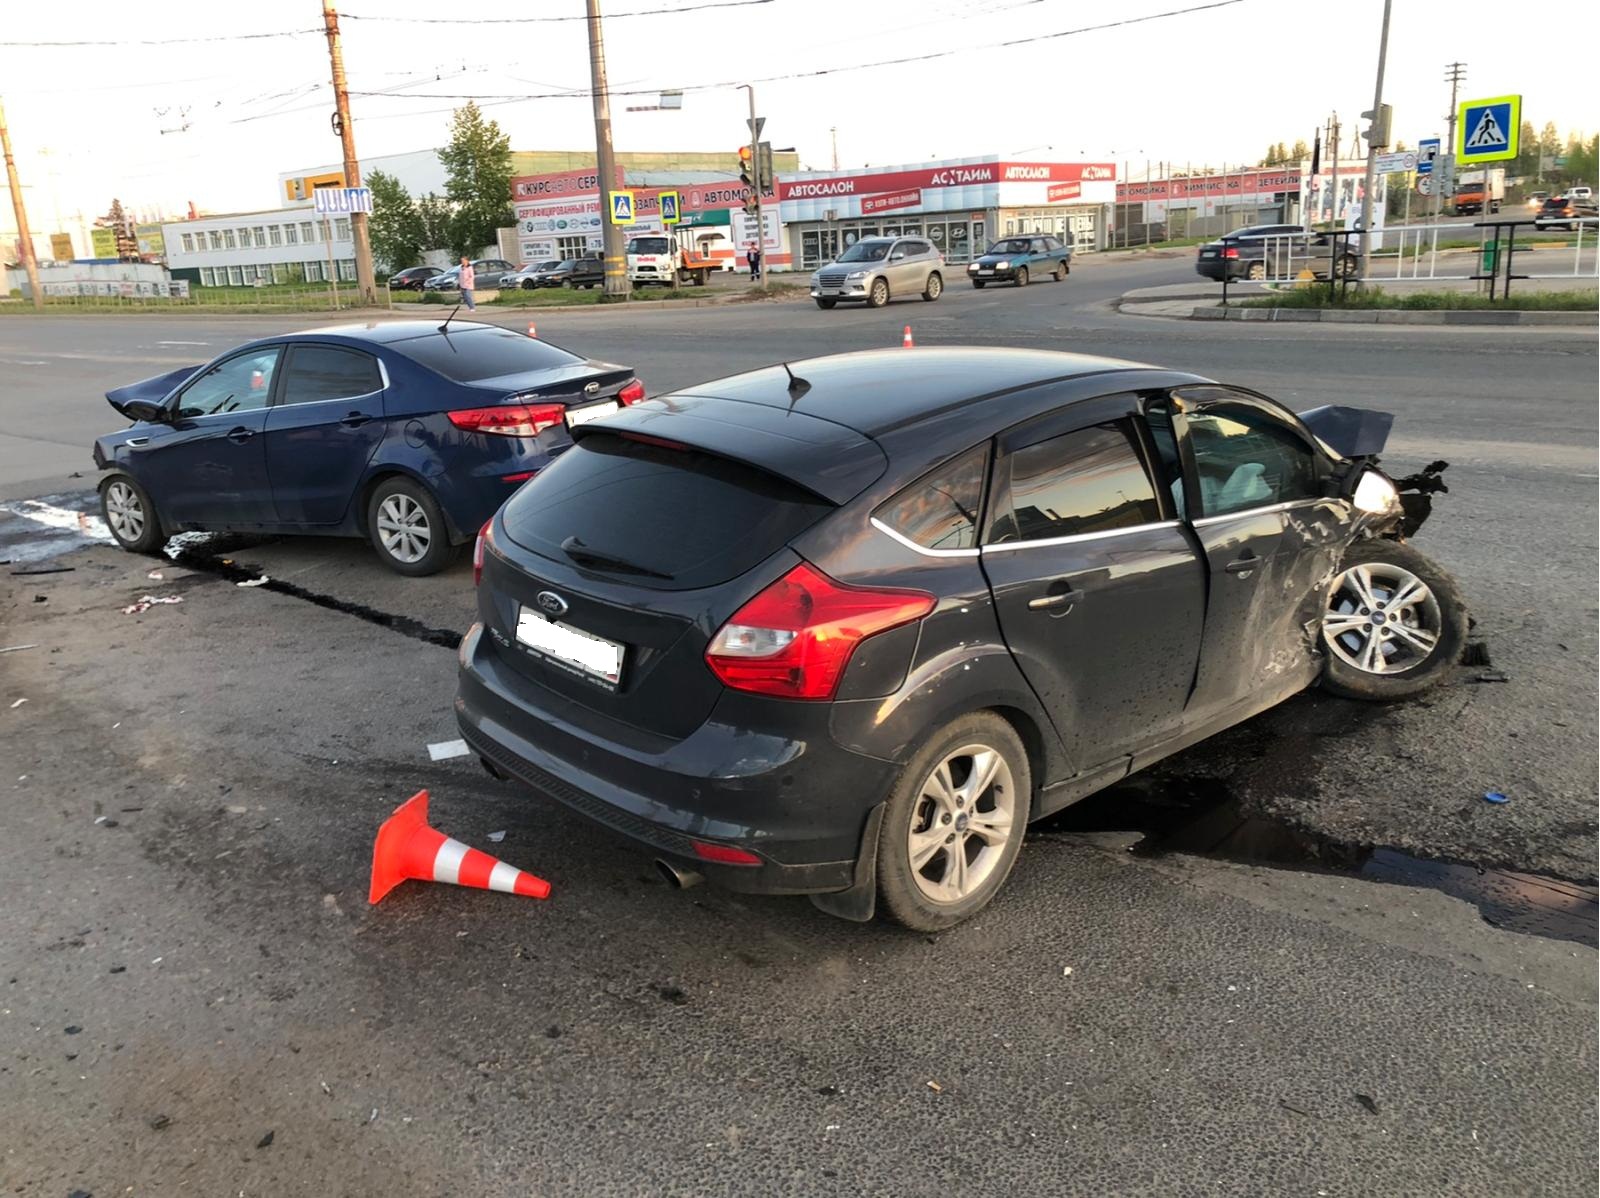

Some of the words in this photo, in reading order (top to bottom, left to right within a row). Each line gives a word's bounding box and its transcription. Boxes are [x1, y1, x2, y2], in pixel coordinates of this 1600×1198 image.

[1004, 167, 1050, 179] АВТОСАЛОН
[526, 175, 600, 195] КУРСАВТОСЕР
[788, 180, 855, 198] АВТОСАЛОН
[1184, 180, 1240, 192] ХИМЧИСКА
[704, 187, 775, 203] АВТОМОКА
[542, 595, 559, 611] Ford
